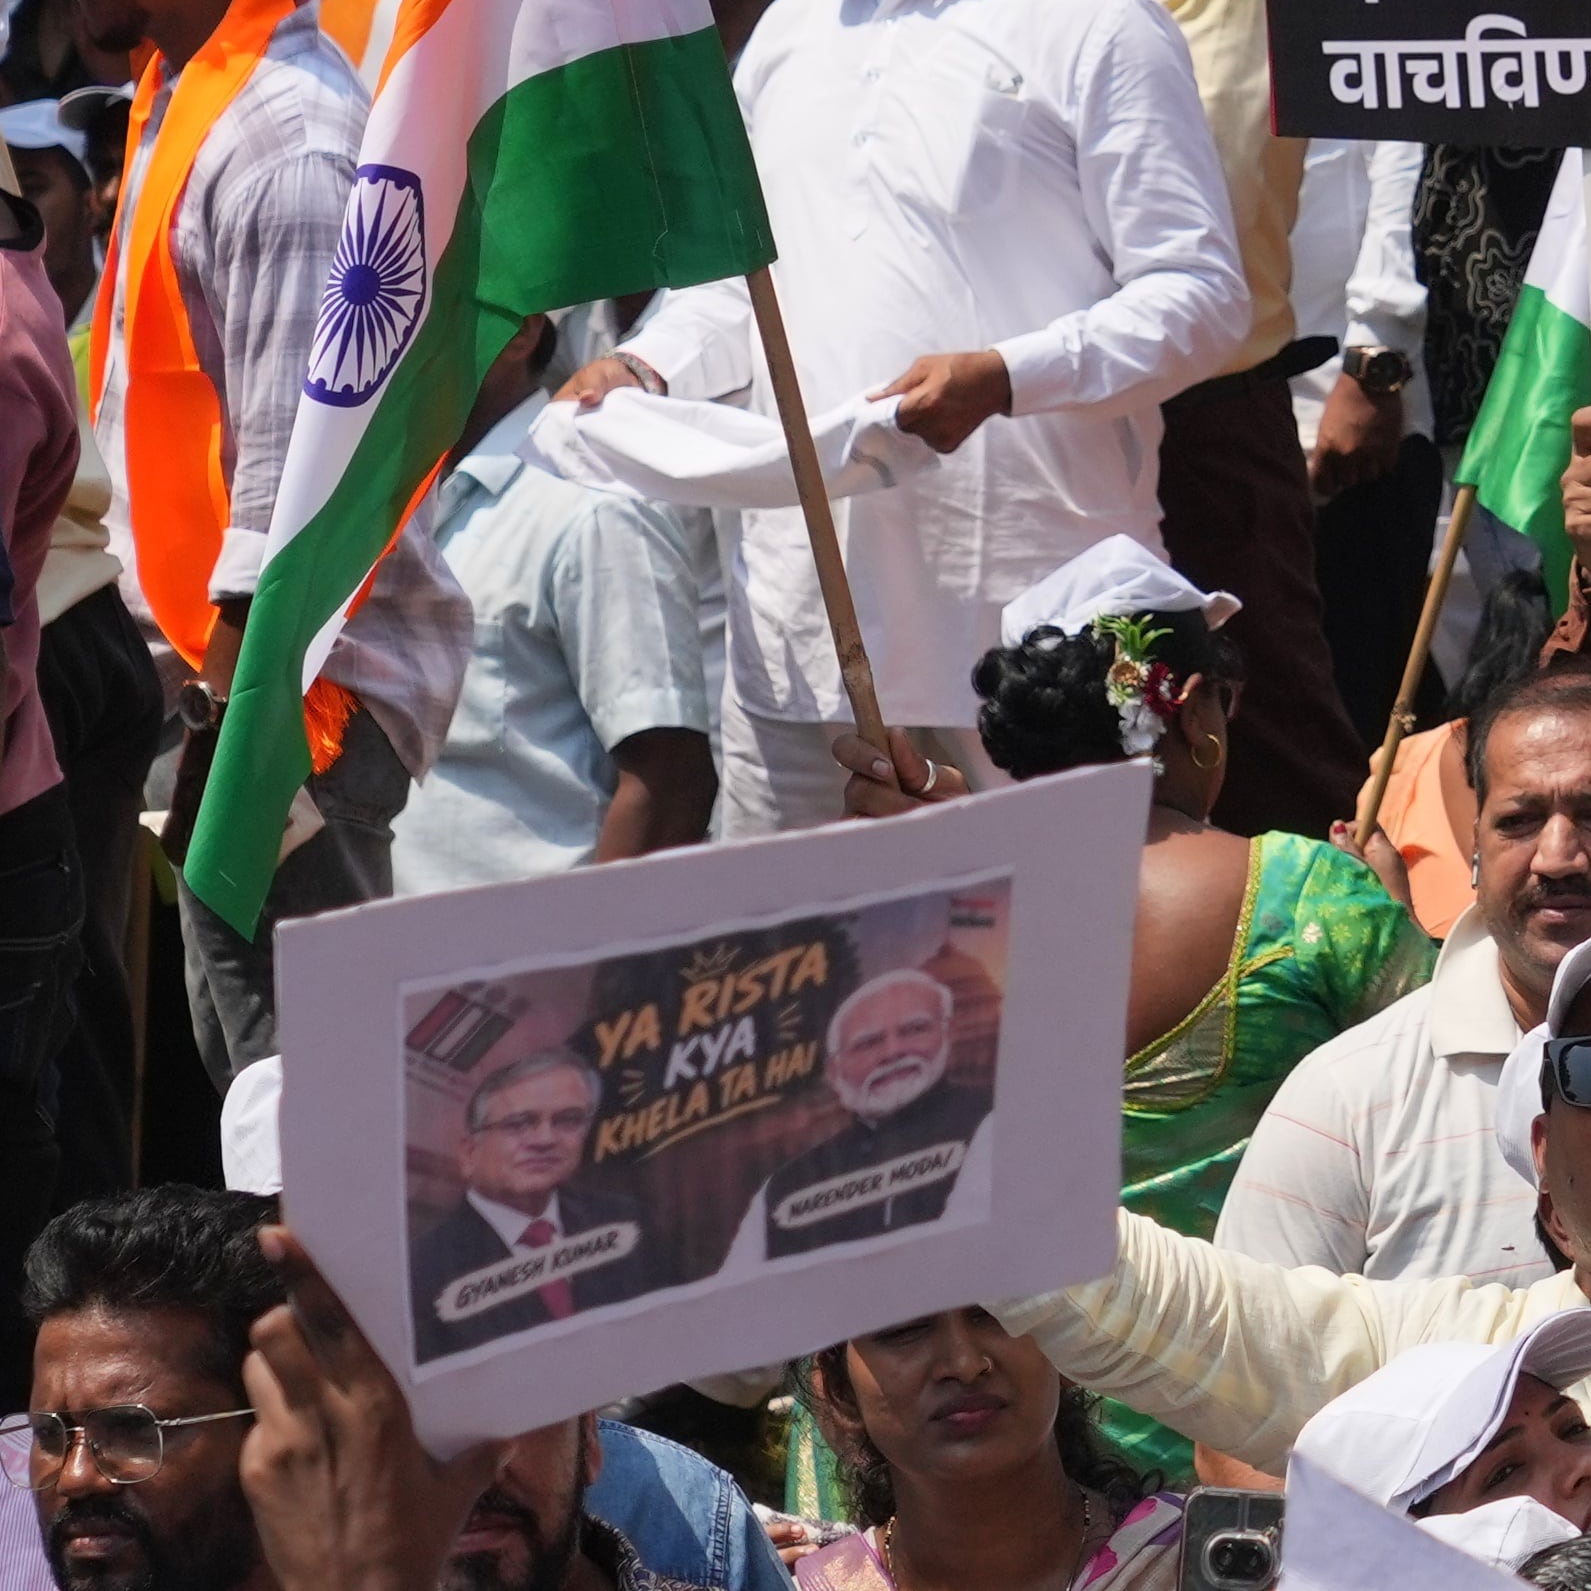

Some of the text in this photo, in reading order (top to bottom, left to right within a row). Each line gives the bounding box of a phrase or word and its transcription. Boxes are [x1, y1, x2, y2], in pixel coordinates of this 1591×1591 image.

[594, 940, 829, 1071] YA RISTA
[663, 1014, 757, 1091] KYA
[594, 1039, 818, 1164] KHELA TA HAI
[789, 1176, 884, 1222] NARENDER
[454, 1229, 620, 1311] GYANESH KUMAR
